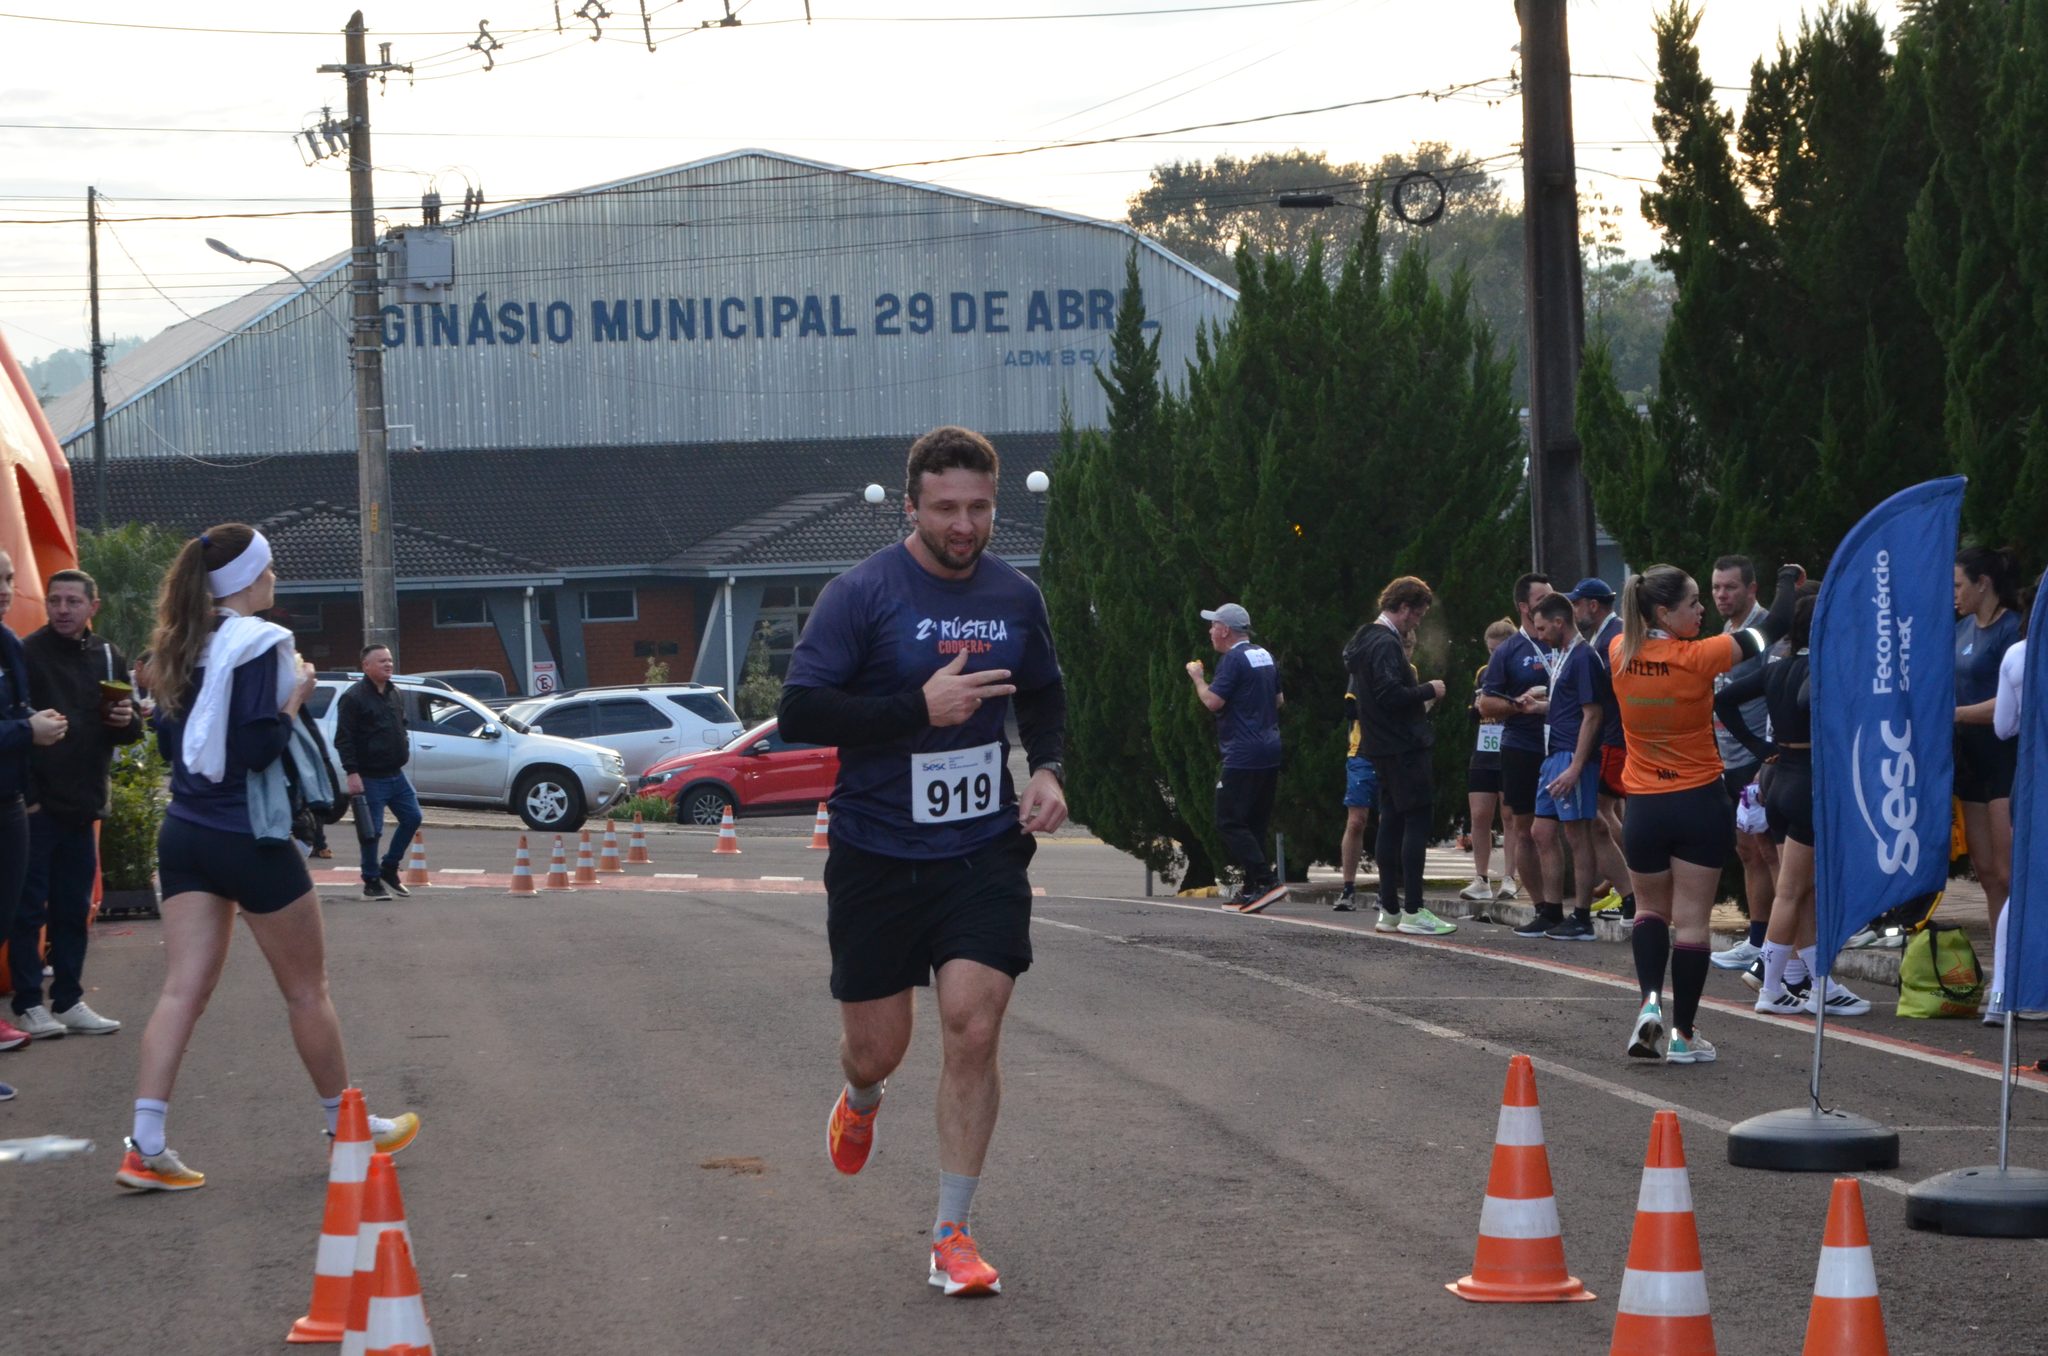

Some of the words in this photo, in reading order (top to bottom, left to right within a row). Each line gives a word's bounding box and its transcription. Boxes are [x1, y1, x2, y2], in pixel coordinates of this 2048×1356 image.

[380, 291, 574, 347] GINÁSIO
[591, 294, 857, 342] MUNICIPAL
[875, 292, 934, 335] 29
[950, 291, 1009, 333] DE
[1026, 288, 1160, 332] ABRL
[1004, 350, 1051, 367] ADM
[941, 616, 1008, 640] RÚSTICA
[1872, 549, 1893, 694] Fecomércio
[1625, 659, 1670, 677] ATLETA
[1897, 615, 1914, 692] senac
[927, 772, 991, 817] 919
[1876, 718, 1920, 875] sesc
